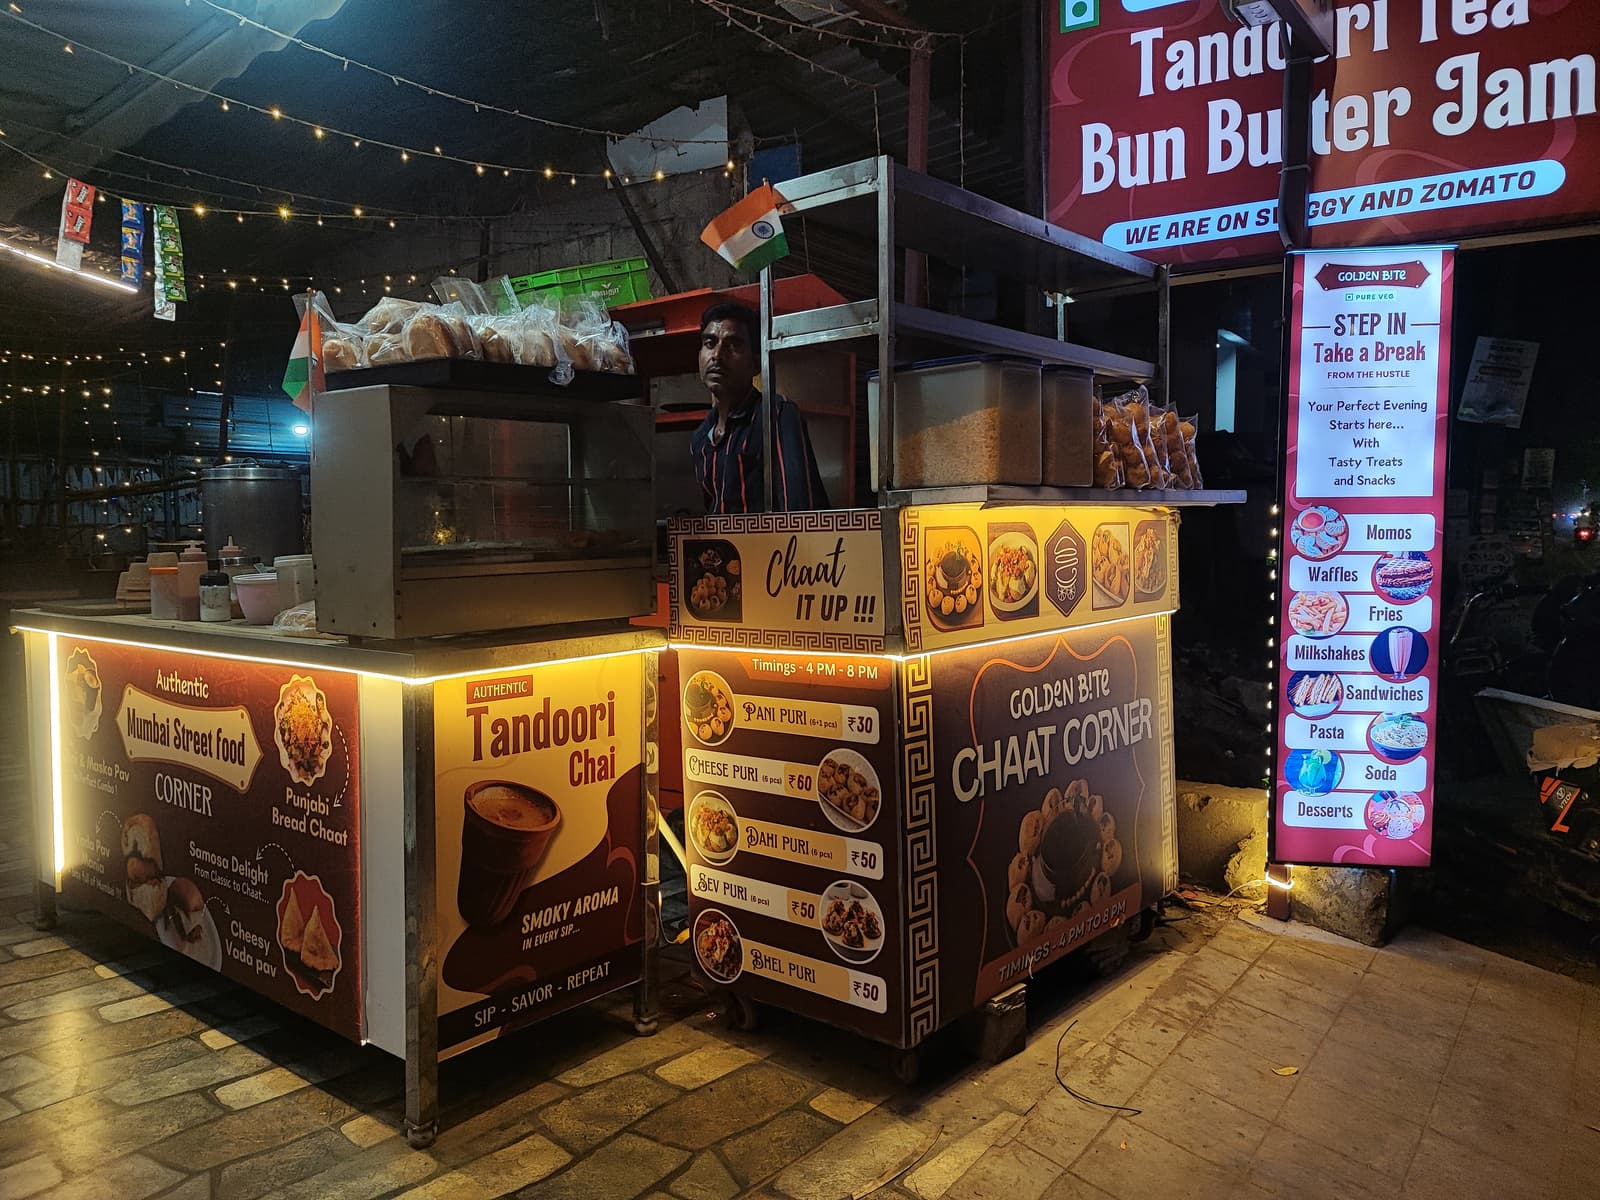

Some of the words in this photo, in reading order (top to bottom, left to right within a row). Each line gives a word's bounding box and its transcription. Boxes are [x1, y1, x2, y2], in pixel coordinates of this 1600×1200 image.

[1130, 0, 1389, 97] Tandori
[1080, 122, 1187, 195] Bun
[1207, 86, 1412, 175] Buter
[1432, 51, 1598, 136] Jam
[1125, 224, 1161, 245] WE
[1165, 216, 1211, 240] ARE
[1216, 211, 1249, 232] ON
[1255, 195, 1355, 226] SGGY
[1359, 188, 1413, 212] AND
[1419, 170, 1537, 203] ZOMATO
[1333, 313, 1382, 337] STEP
[1387, 312, 1407, 336] IN
[1313, 342, 1354, 364] Take
[1359, 347, 1369, 362] a
[1374, 340, 1426, 362] Break
[1327, 371, 1354, 379] FROM
[1375, 370, 1410, 378] HUSTLE
[1308, 401, 1333, 412] Your
[1337, 400, 1380, 411] Perfect
[1383, 400, 1428, 413] Evening
[1329, 419, 1365, 430] Starts
[1368, 419, 1404, 430] here...
[1352, 437, 1379, 449] With
[1328, 456, 1362, 469] Tasty
[1366, 456, 1403, 467] Treats
[1334, 475, 1353, 486] and
[1357, 474, 1396, 486] Snacks
[1366, 524, 1412, 540] Momos
[766, 535, 846, 597] Chaat
[1308, 566, 1358, 582] Waffles
[796, 594, 816, 621] IT
[820, 594, 848, 621] UP
[853, 595, 876, 623] !!!
[1369, 606, 1403, 621] Fries
[1294, 645, 1365, 661] Milkshakes
[751, 658, 796, 676] Timings
[806, 662, 813, 675] 4
[817, 663, 836, 676] PM
[847, 665, 855, 677] 8
[858, 666, 878, 679] PM
[156, 669, 210, 699] Authentic
[473, 680, 529, 699] AUTHENTIC
[1346, 685, 1423, 701] Sandwiches
[127, 707, 170, 747] Mumbai
[173, 717, 213, 759] Street
[466, 690, 616, 762] Tandoori
[780, 708, 807, 725] PURI
[823, 719, 838, 729] pcs)
[847, 716, 873, 734] ₹30
[1310, 724, 1345, 739] Pasta
[952, 725, 1057, 803] CHAAT
[1063, 697, 1153, 766] CORNER
[114, 763, 130, 782] Pav
[569, 745, 616, 787] Chai
[732, 765, 758, 782] PURI
[769, 776, 782, 785] pcs)
[788, 774, 812, 792] ₹60
[1365, 765, 1397, 781] Soda
[154, 772, 213, 817] CORNER
[286, 787, 330, 816] Punjabi
[1298, 801, 1353, 818] Desserts
[272, 806, 307, 834] Bread
[309, 818, 348, 846] Chaat
[189, 840, 229, 869] Samosa
[231, 855, 269, 886] Delight
[782, 836, 810, 855] PURI
[819, 850, 833, 860] pcs)
[851, 850, 876, 870] ₹50
[194, 863, 210, 878] From
[210, 869, 232, 890] Classic
[233, 879, 241, 892] to
[521, 901, 572, 935] SMOKY
[573, 886, 619, 918] AROMA
[723, 884, 748, 901] PURI
[757, 896, 770, 906] pcs)
[791, 900, 815, 920] ₹50
[230, 920, 271, 956] Cheesy
[522, 938, 532, 951] IN
[534, 928, 559, 947] EVERY
[998, 942, 1051, 983] TIMINGS
[1059, 934, 1068, 948] 4
[1068, 923, 1086, 944] PM
[1086, 913, 1101, 932] TO
[1102, 908, 1110, 923] 8
[1110, 898, 1127, 920] PM
[225, 938, 253, 965] Vada
[256, 958, 277, 977] pav
[474, 1006, 497, 1028] SIP
[511, 983, 554, 1013] SAVOR
[567, 961, 611, 991] REPEAT
[788, 962, 816, 984] PURI
[853, 980, 879, 1001] ₹50
